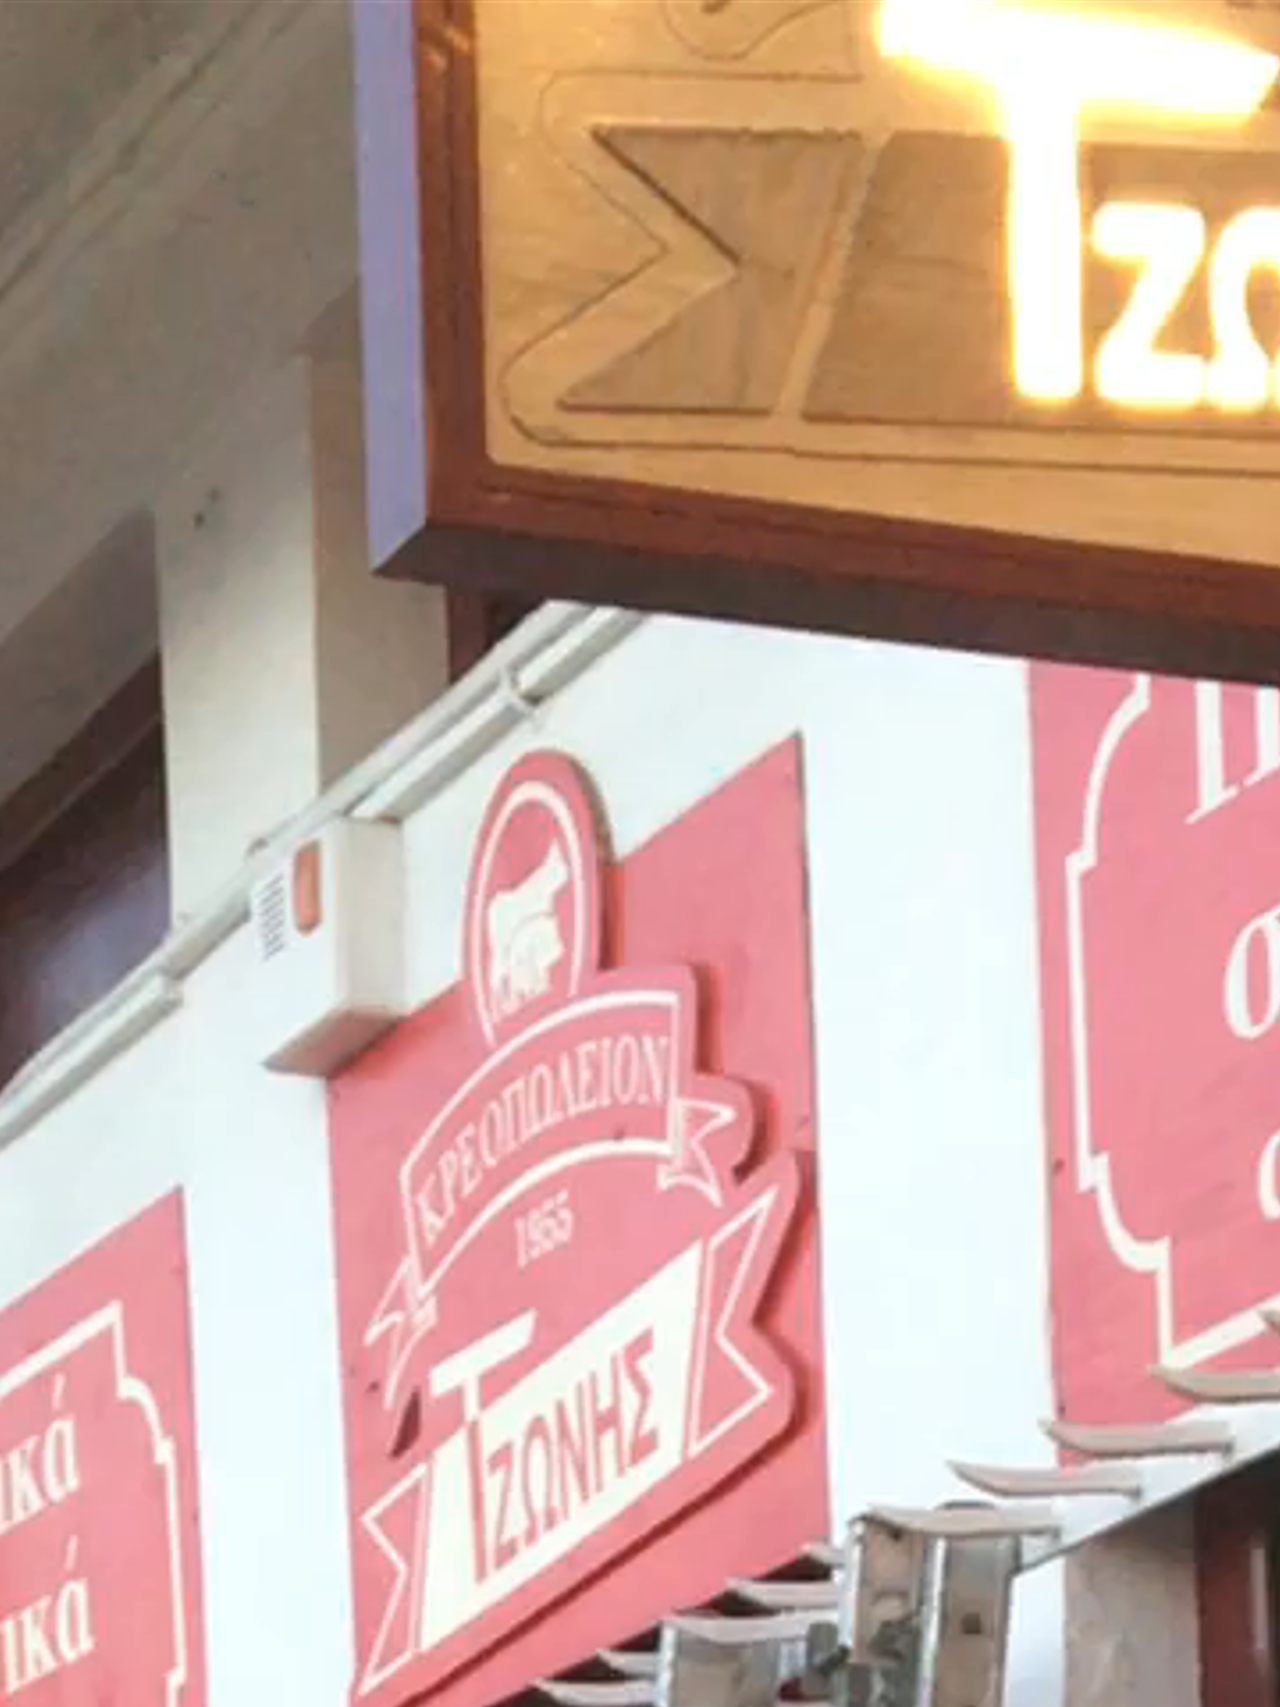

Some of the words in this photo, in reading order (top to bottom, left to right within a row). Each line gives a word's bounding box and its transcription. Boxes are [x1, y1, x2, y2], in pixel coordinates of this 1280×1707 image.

[416, 1035, 670, 1237] ΚΡΕΟΠΩΛΕΙΟΝ
[514, 1190, 574, 1270] 1955
[430, 1309, 657, 1586] ΤΖΩΝΗΣ
